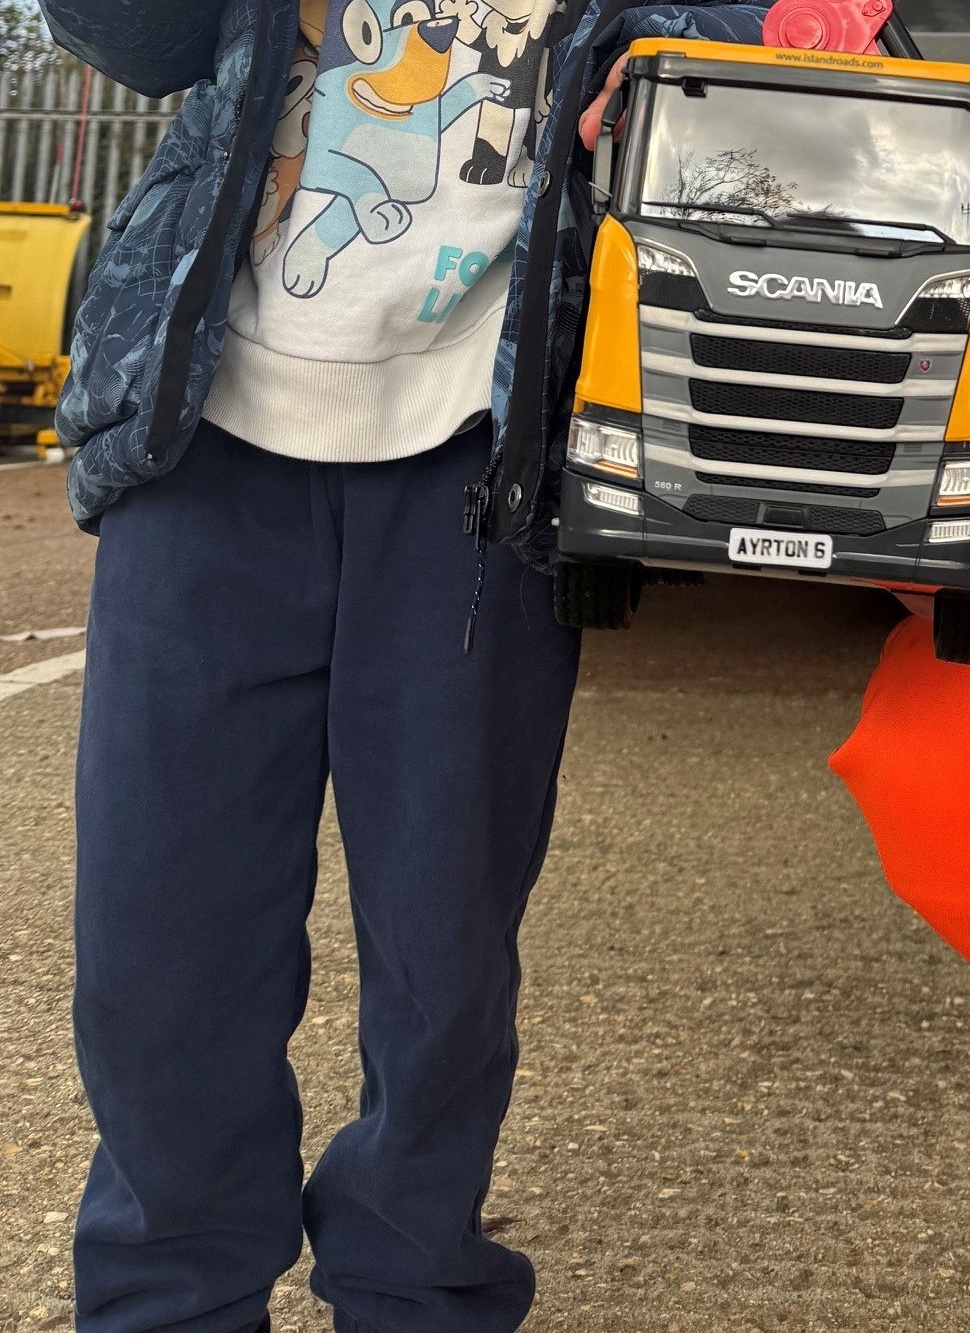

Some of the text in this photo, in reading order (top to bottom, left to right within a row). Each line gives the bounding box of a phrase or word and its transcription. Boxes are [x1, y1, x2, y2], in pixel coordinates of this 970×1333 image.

[775, 52, 884, 69] www.islandroads.com
[727, 270, 883, 309] SCANIA
[673, 482, 682, 491] R
[737, 537, 825, 559] AYRTON 6
